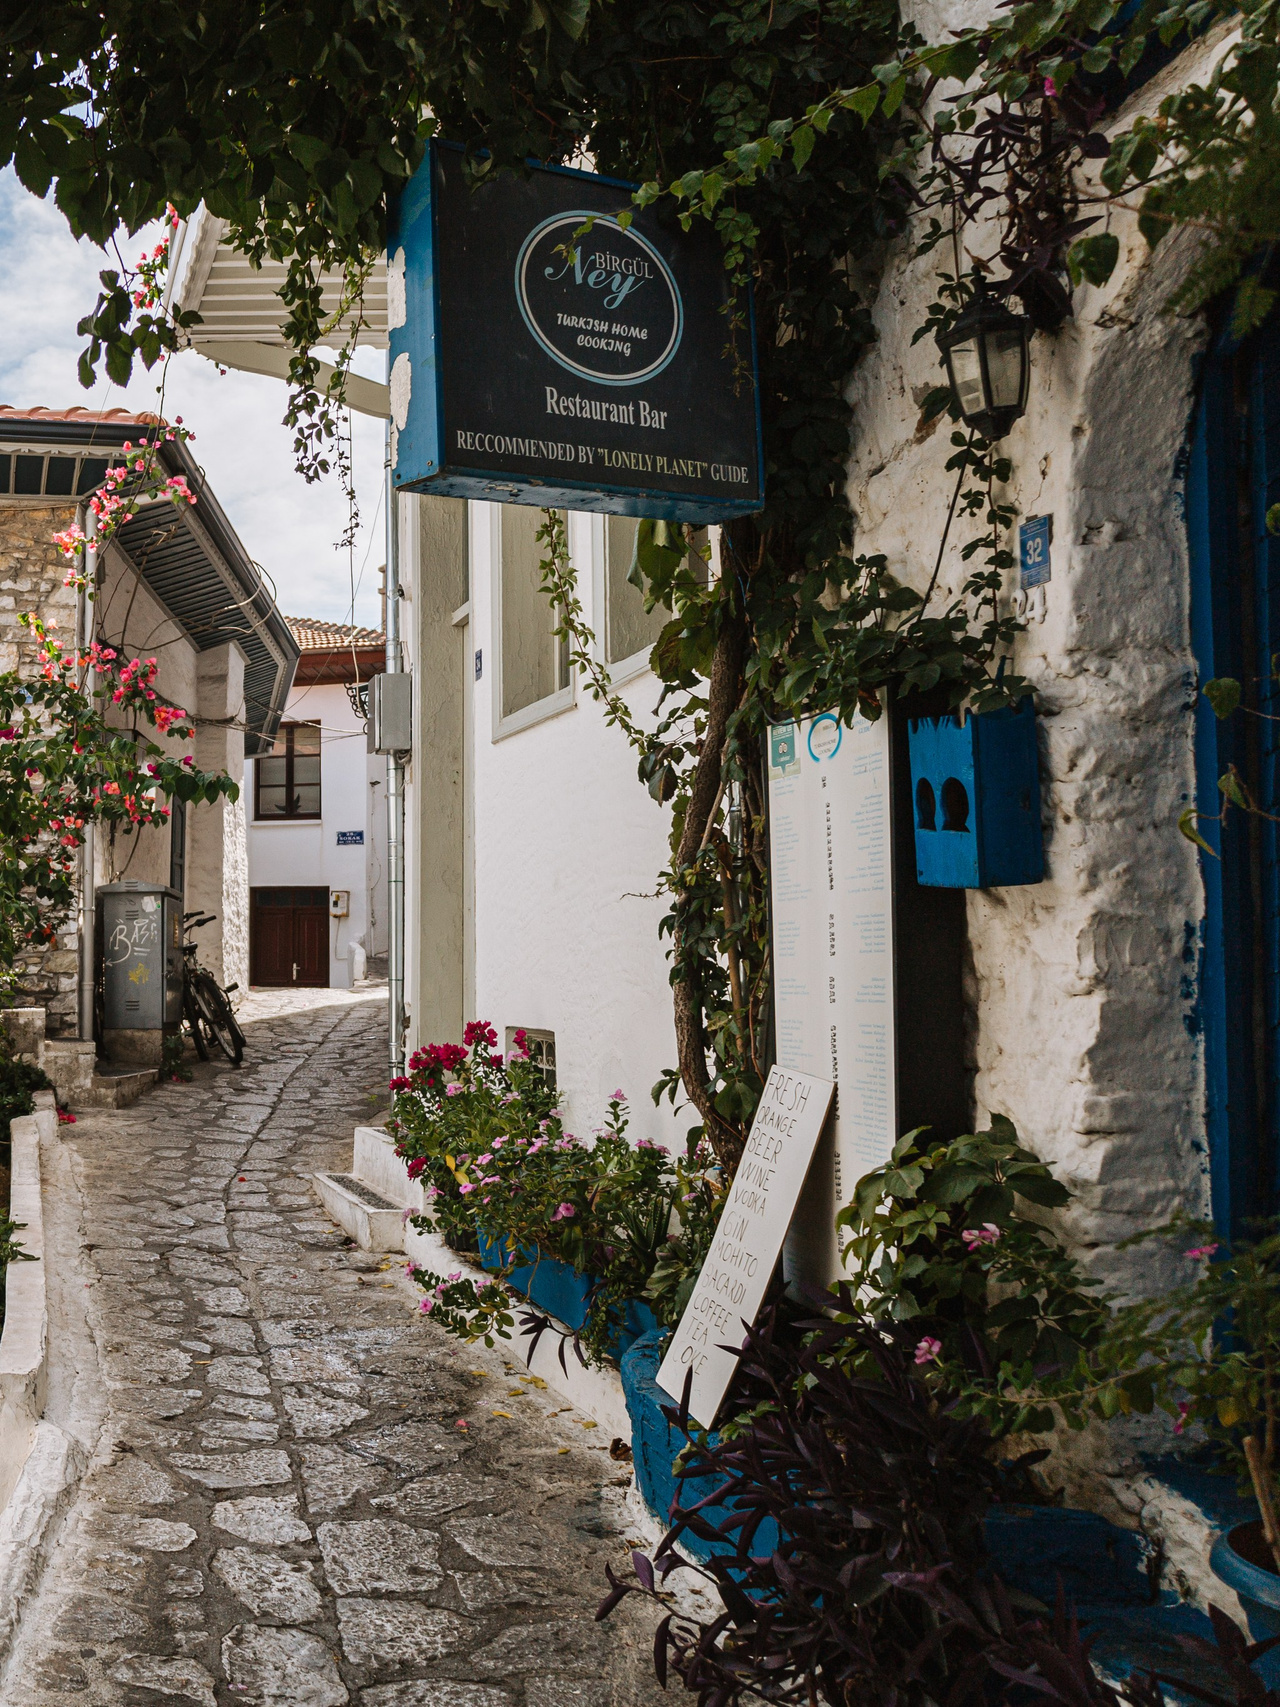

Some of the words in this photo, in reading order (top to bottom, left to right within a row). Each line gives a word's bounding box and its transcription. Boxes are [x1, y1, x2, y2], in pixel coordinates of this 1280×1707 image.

[544, 246, 645, 309] Ney
[595, 251, 654, 279] BİRGÜL
[557, 313, 609, 333] TURKISH
[611, 323, 648, 340] HOME
[577, 334, 631, 357] COOKING
[545, 386, 635, 425] Restaurant
[638, 400, 667, 430] Bar
[456, 430, 575, 462] RECCOMMENDED
[578, 447, 595, 465] BY
[710, 465, 749, 484] GUIDE
[1026, 537, 1042, 565] 32
[1010, 585, 1047, 626] 24
[764, 1071, 812, 1113] FRESH
[756, 1105, 797, 1138] ORANGE
[747, 1127, 783, 1164] BEER
[741, 1161, 776, 1192] WINE
[734, 1186, 767, 1216] VODKA
[693, 1292, 733, 1336] COFFEE
[686, 1316, 709, 1346] TEA
